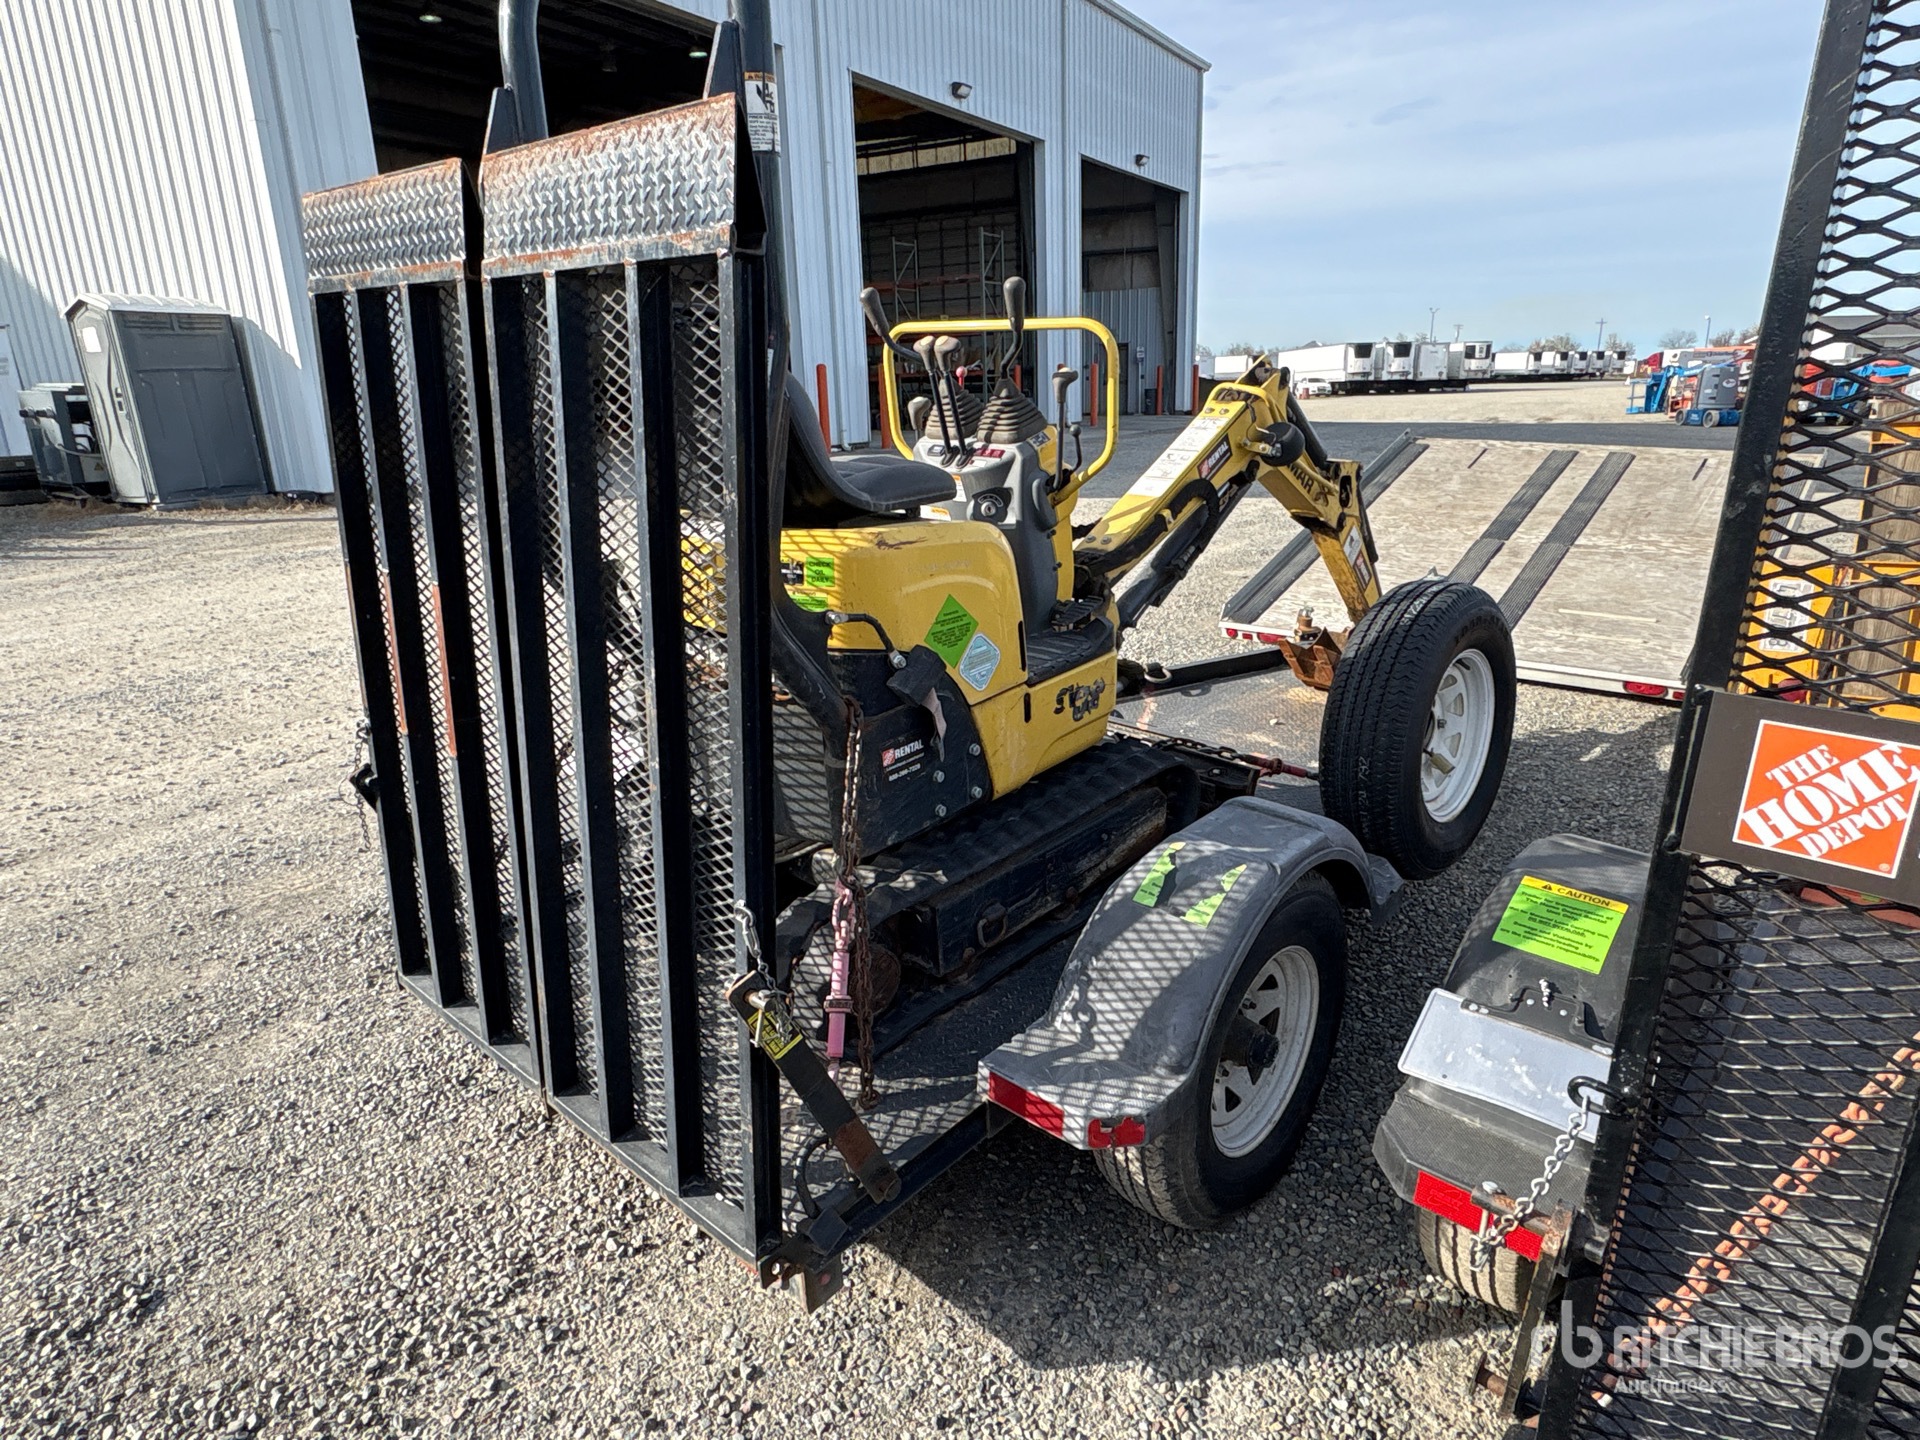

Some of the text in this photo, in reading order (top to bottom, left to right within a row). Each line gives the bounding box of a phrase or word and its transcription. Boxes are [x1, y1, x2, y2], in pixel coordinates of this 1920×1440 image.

[894, 739, 925, 760] RENTAL
[1765, 744, 1841, 789] THE
[1741, 741, 1920, 847] HOME
[1796, 793, 1909, 858] DEPOT
[1557, 887, 1612, 907] CAUTION
